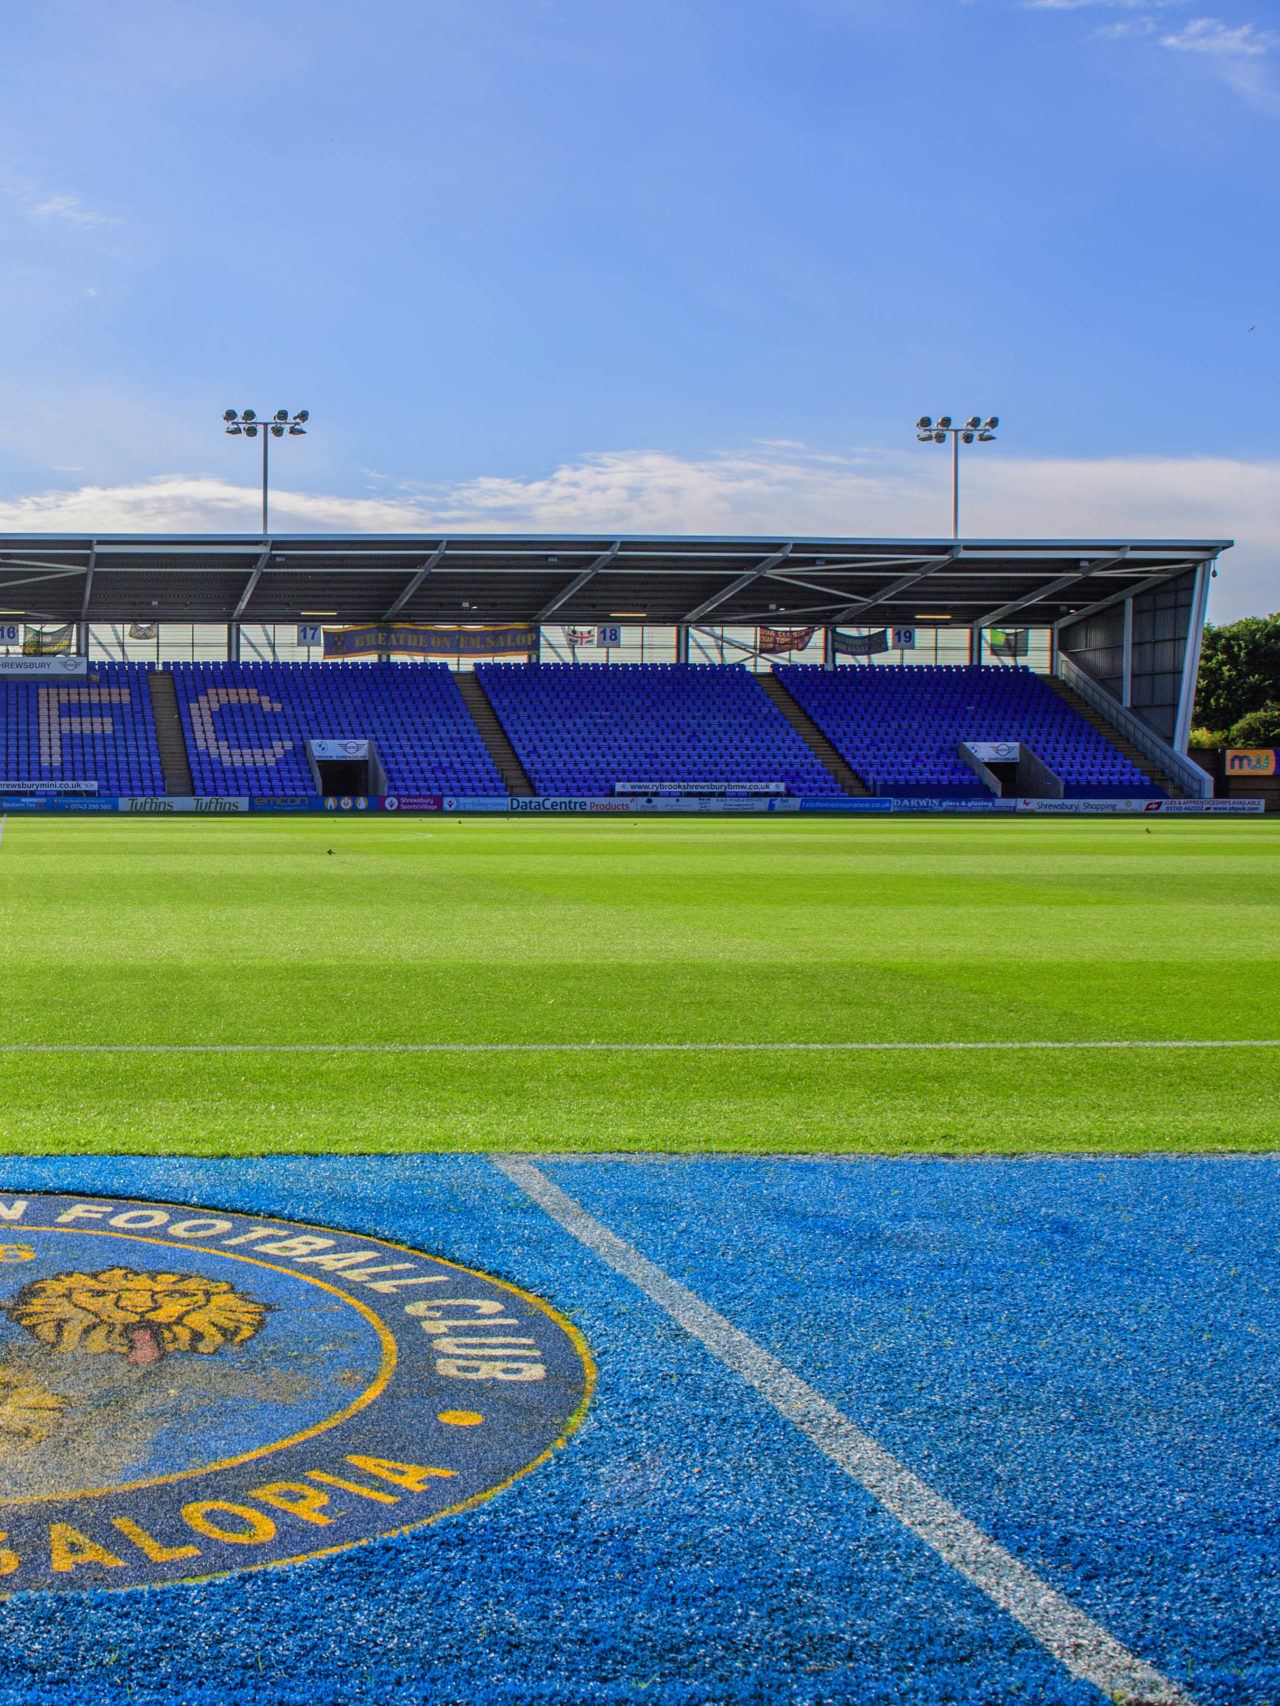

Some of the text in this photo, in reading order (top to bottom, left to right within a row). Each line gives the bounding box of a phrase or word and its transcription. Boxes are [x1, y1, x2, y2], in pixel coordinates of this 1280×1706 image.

[299, 626, 318, 641] 17
[599, 628, 618, 642] 18
[894, 629, 913, 643] 19
[353, 632, 429, 649] BREATHE
[430, 635, 451, 648] ON
[128, 798, 175, 811] Tuffins
[193, 798, 239, 811] Tuffins
[254, 797, 309, 805] emcon
[400, 797, 434, 805] Shrewsbury
[419, 803, 438, 811] Village
[510, 797, 587, 810] DataCentre
[589, 801, 630, 811] Products
[893, 799, 939, 807] DARWIN
[967, 801, 993, 809] glazing
[1036, 801, 1079, 813] Shrewsbury
[1082, 802, 1117, 812] Shopping
[55, 1204, 452, 1294] FOOTBALL
[404, 1298, 548, 1382] CLUB
